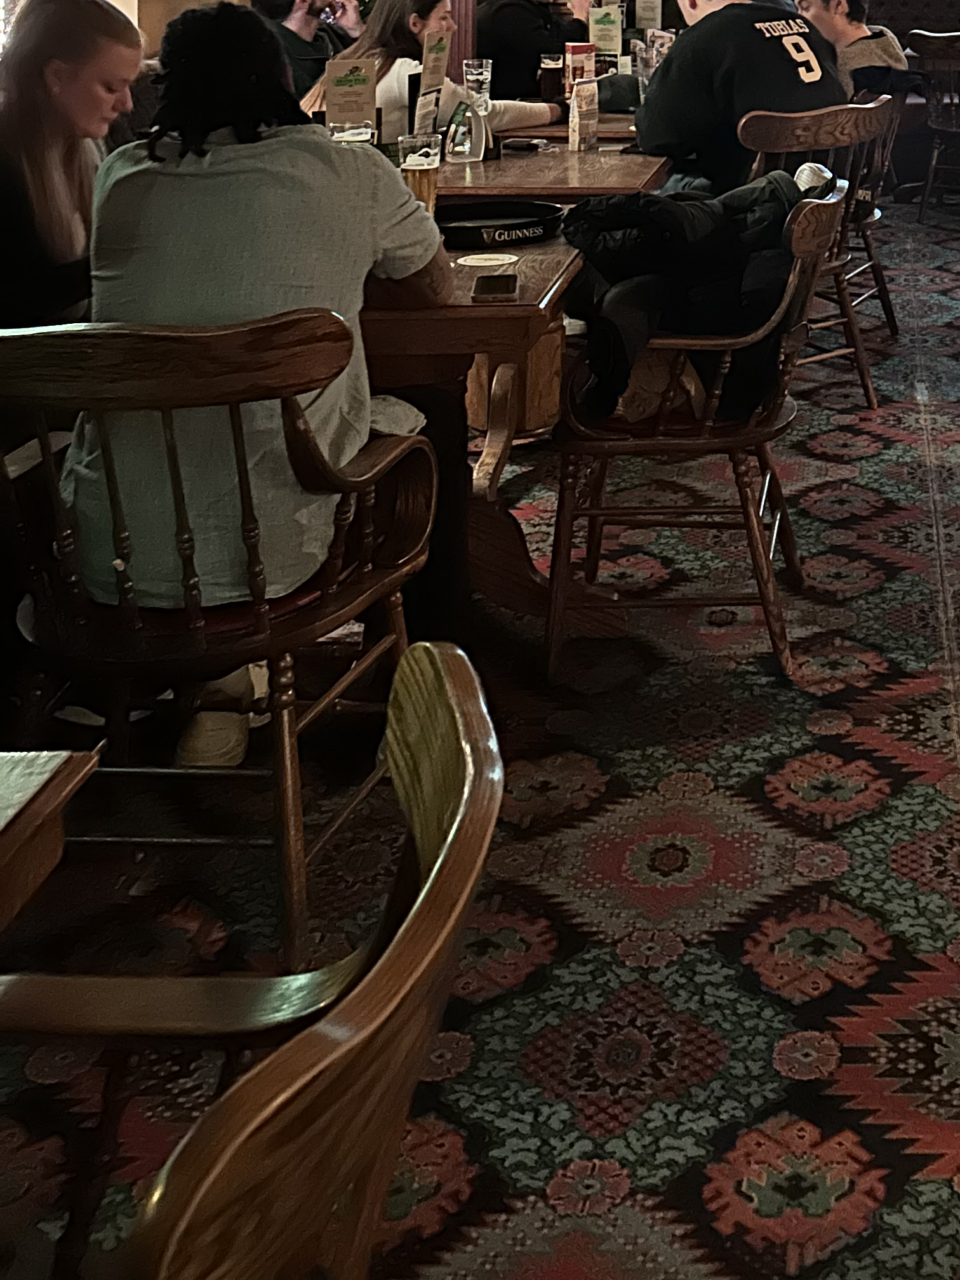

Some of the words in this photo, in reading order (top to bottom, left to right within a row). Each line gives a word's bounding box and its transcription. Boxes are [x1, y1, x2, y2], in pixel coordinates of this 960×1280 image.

[754, 18, 810, 38] TOBIAS
[781, 34, 823, 83] 9
[494, 225, 544, 241] GUINNESS
